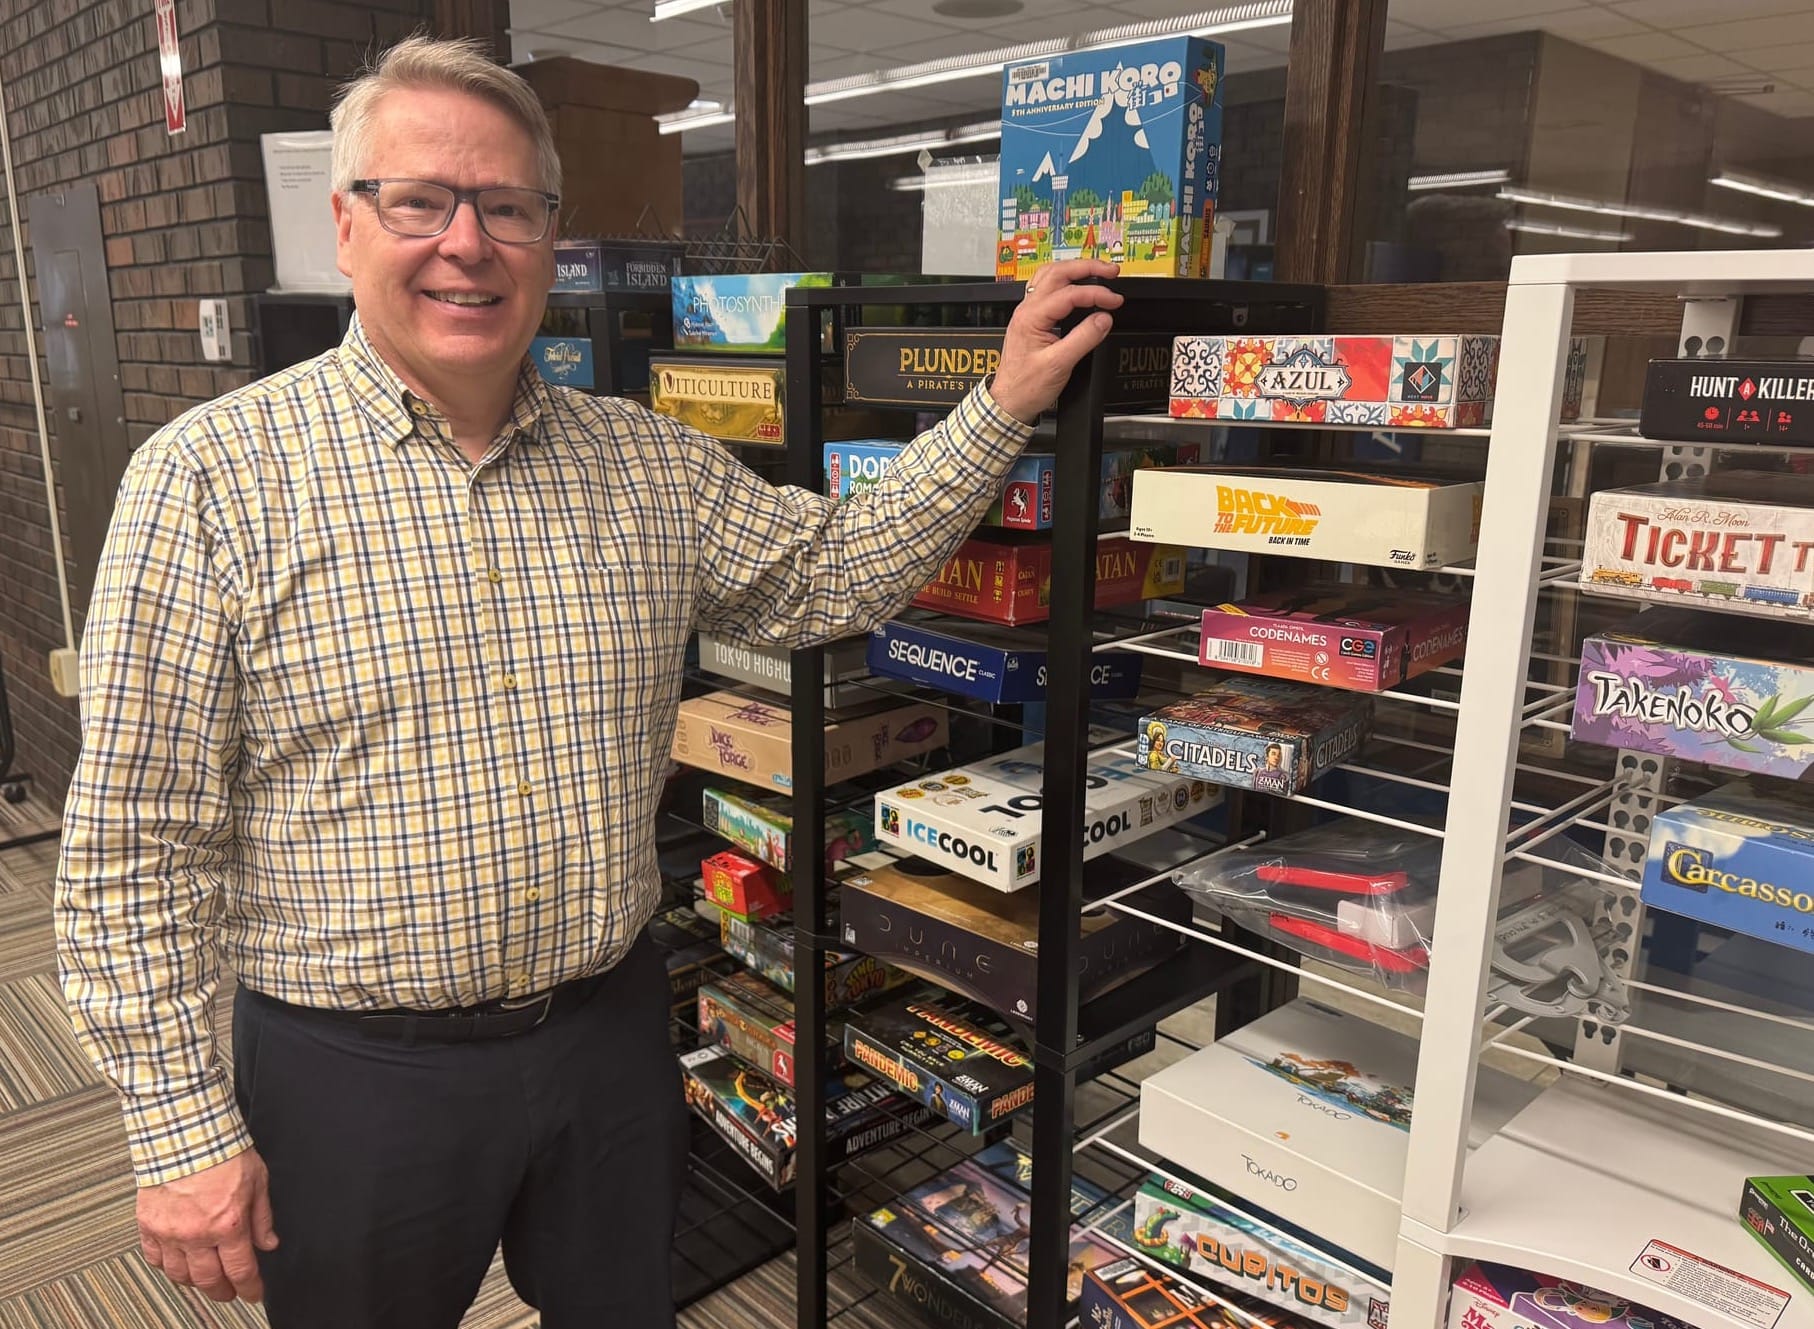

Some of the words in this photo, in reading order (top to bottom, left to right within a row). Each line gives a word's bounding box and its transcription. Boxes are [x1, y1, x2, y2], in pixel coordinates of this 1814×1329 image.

[1005, 73, 1095, 106] MACHI
[1100, 61, 1183, 93] KORO
[1026, 102, 1074, 115] ANNIVERSARY
[1184, 102, 1199, 180] KORO
[1179, 185, 1195, 277] MACHI
[556, 263, 588, 279] ISLAND
[625, 262, 667, 273] FORBIDDEN
[625, 273, 668, 288] ISLAND
[899, 347, 1001, 374] PLUNDER
[663, 371, 773, 400] VITICULTURE
[906, 380, 914, 389] A
[918, 380, 965, 391] PIRATE'S
[1270, 370, 1333, 390] AZUL
[1689, 375, 1740, 398] HUNT
[1216, 485, 1300, 518] BACK
[1213, 523, 1233, 533] THE
[1232, 513, 1319, 536] FUTURE
[1217, 512, 1234, 524] TO
[1657, 507, 1692, 522] Alan
[1714, 511, 1751, 528] Moon
[1268, 536, 1285, 545] BACK
[1286, 537, 1294, 545] IN
[1294, 538, 1310, 546] TIME
[1389, 549, 1417, 561] Funko
[1616, 511, 1786, 575] TICKET
[1249, 626, 1327, 647] CODENAMES
[1413, 625, 1465, 662] CODENAMES
[714, 642, 751, 672] TOKYO
[888, 638, 980, 683] SEQUENCE
[1587, 671, 1760, 740] TAKENOKO
[1166, 738, 1258, 774] CITADELS
[1316, 722, 1359, 769] CITADELS
[906, 818, 998, 873] ICECOOL
[853, 1039, 919, 1093] PANDEMIC
[715, 1110, 751, 1153] ADVENTURE
[750, 1141, 774, 1175] BEGINS
[846, 1120, 899, 1154] ADVENTURE
[1780, 1215, 1798, 1241] The
[1196, 1233, 1350, 1313] CUBITOS
[1471, 1296, 1500, 1319] Disney
